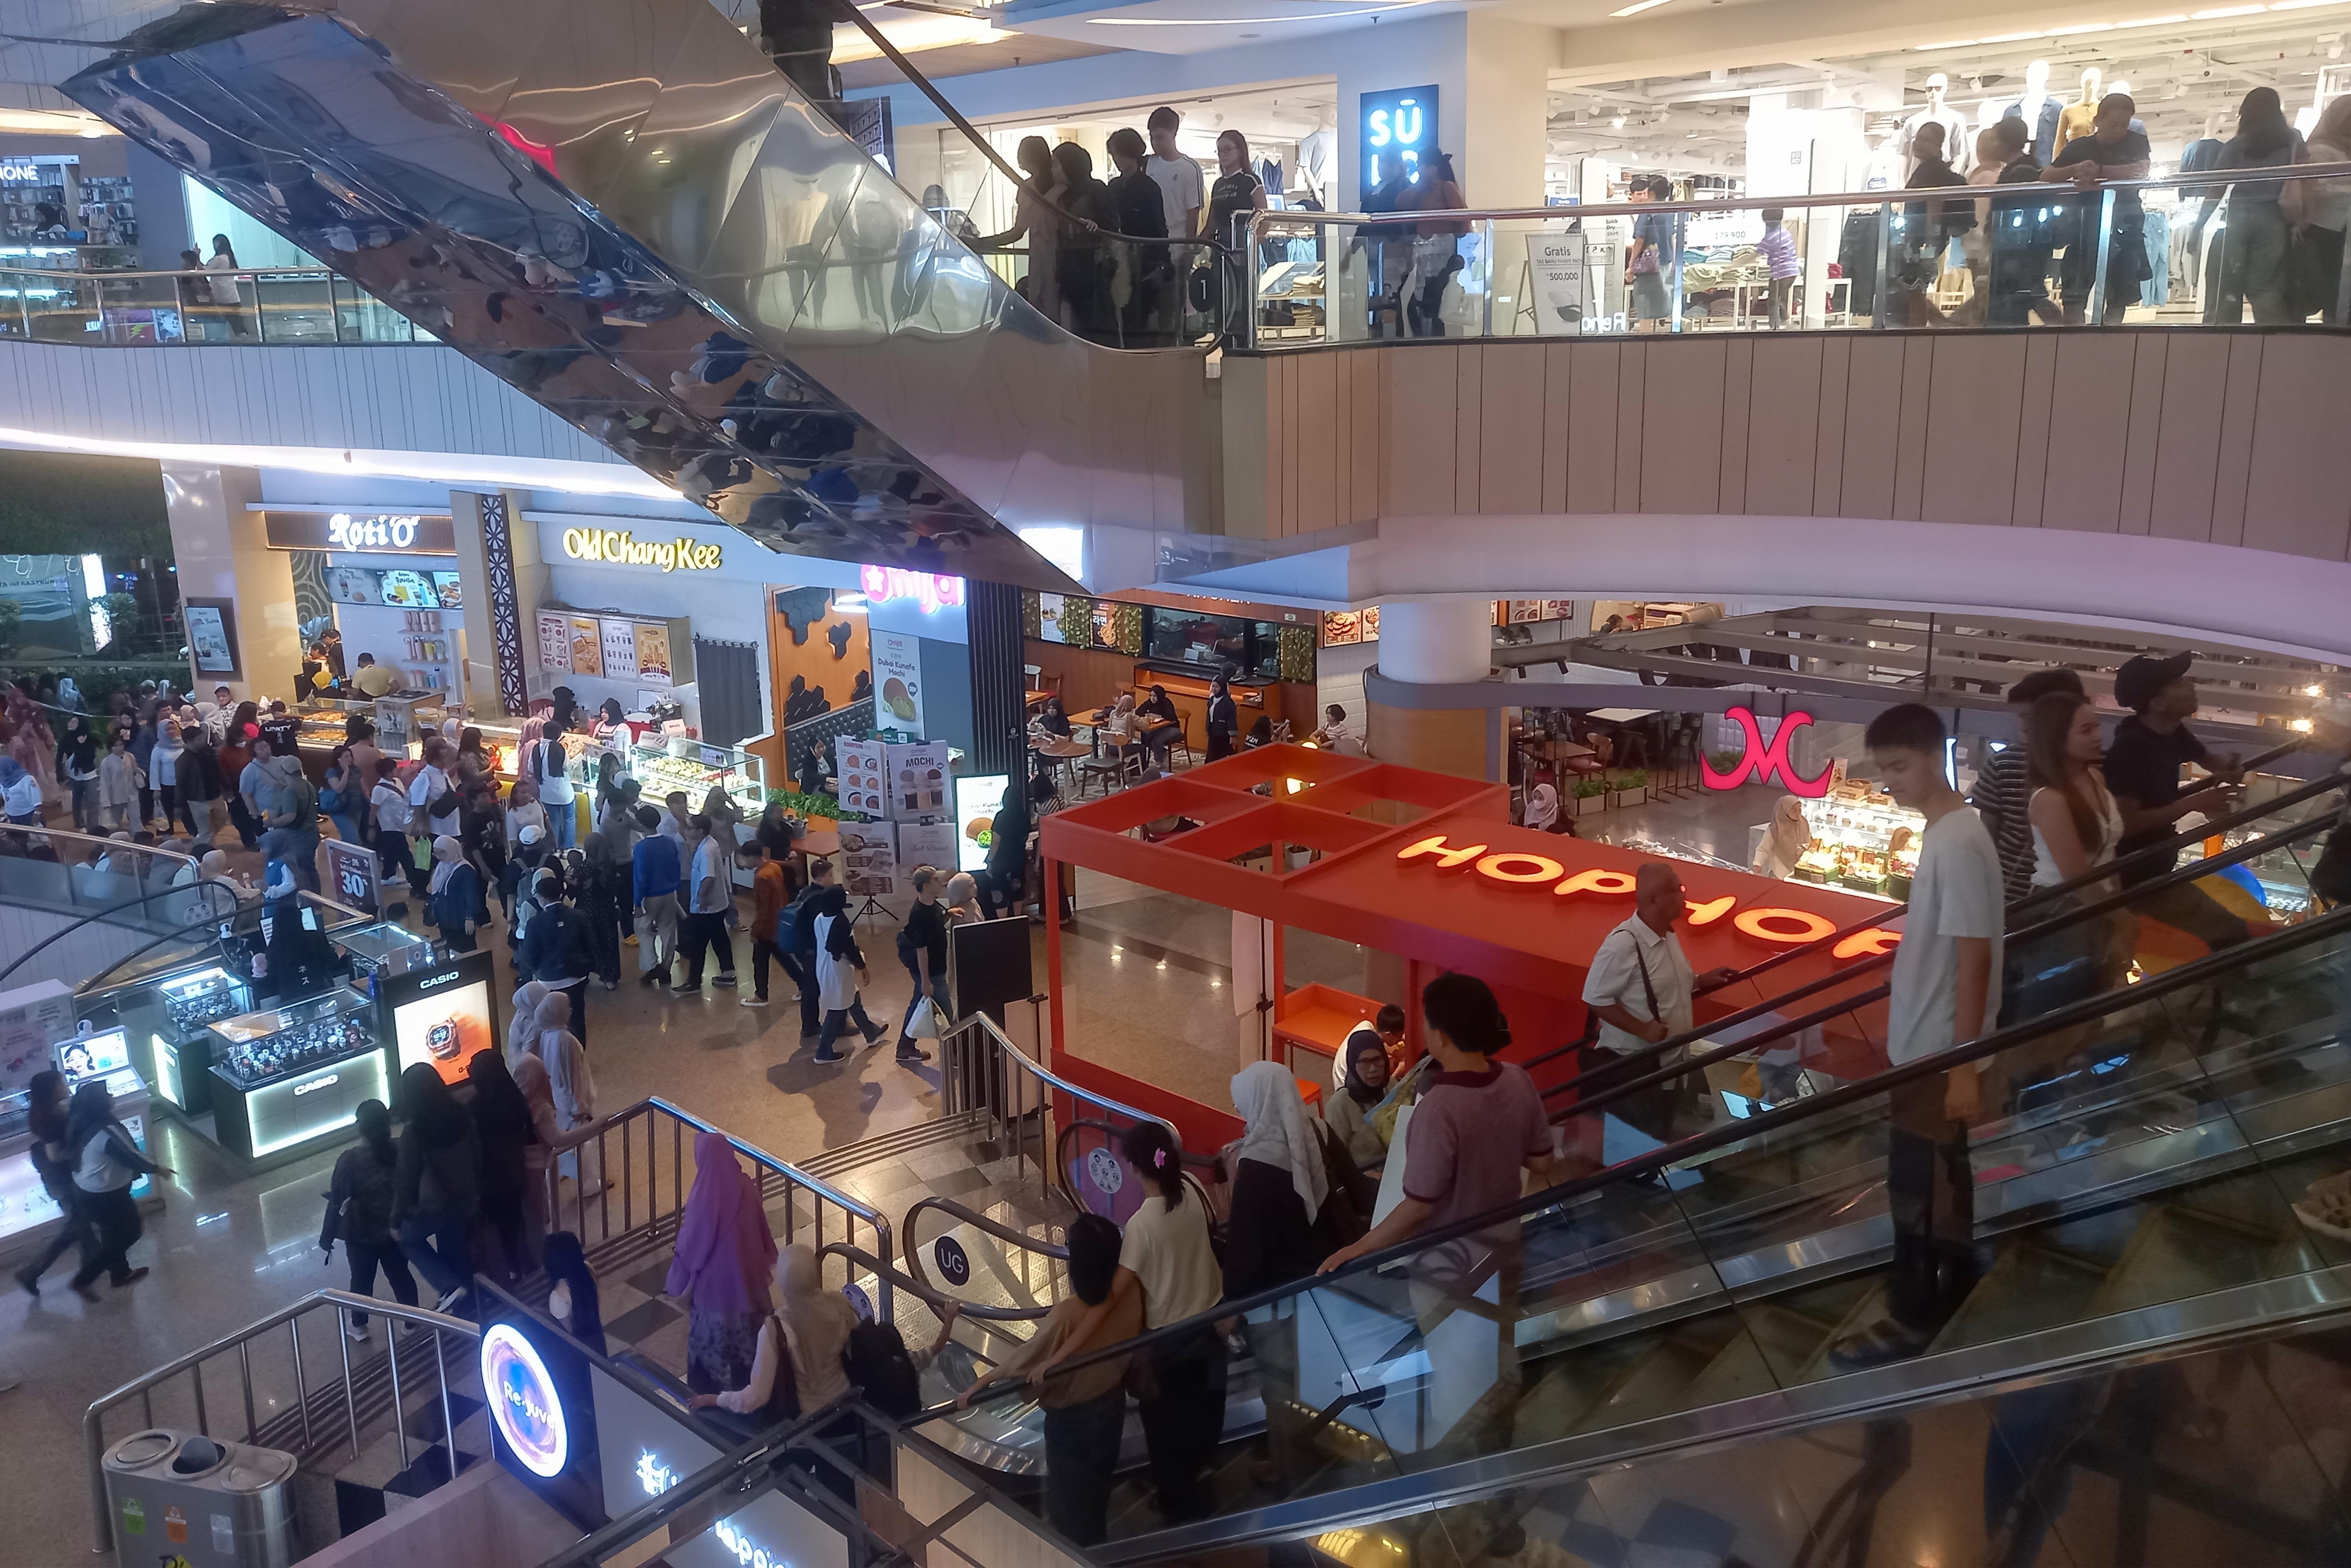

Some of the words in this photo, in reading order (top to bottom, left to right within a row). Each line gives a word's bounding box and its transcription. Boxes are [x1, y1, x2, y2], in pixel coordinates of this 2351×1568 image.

[1544, 246, 1571, 256] Gratis
[1550, 272, 1578, 281] 500,000
[1201, 280, 1206, 300] 1
[562, 528, 604, 561] Old
[602, 531, 676, 573] Chang
[676, 537, 722, 570] Kee
[878, 658, 894, 668] Dubai
[895, 661, 915, 671] Kunafa
[889, 668, 905, 677] Mochi
[905, 757, 934, 768] MOCHI
[420, 971, 459, 989] CASIO
[940, 1249, 964, 1274] UG
